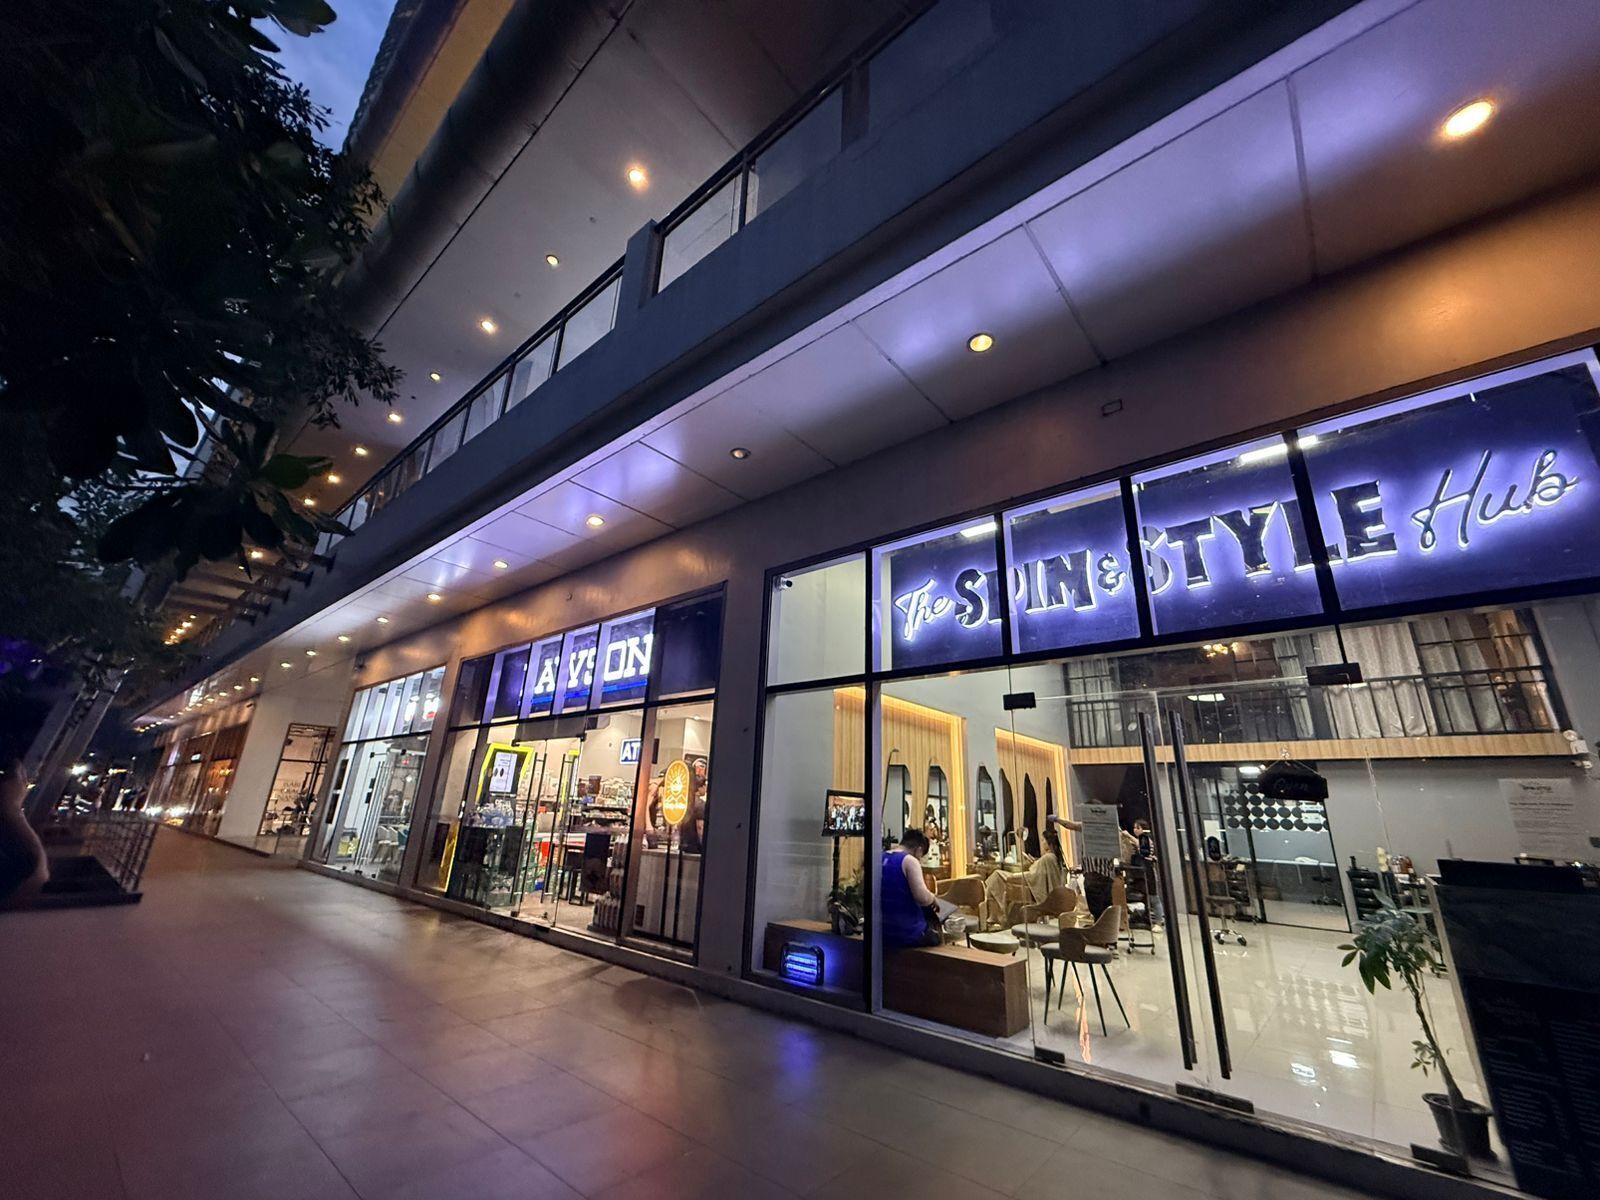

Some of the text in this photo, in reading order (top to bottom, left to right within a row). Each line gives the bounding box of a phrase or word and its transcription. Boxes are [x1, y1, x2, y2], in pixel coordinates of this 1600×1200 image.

[895, 578, 955, 641] The
[1098, 552, 1127, 596] &
[1411, 448, 1580, 552] Hub
